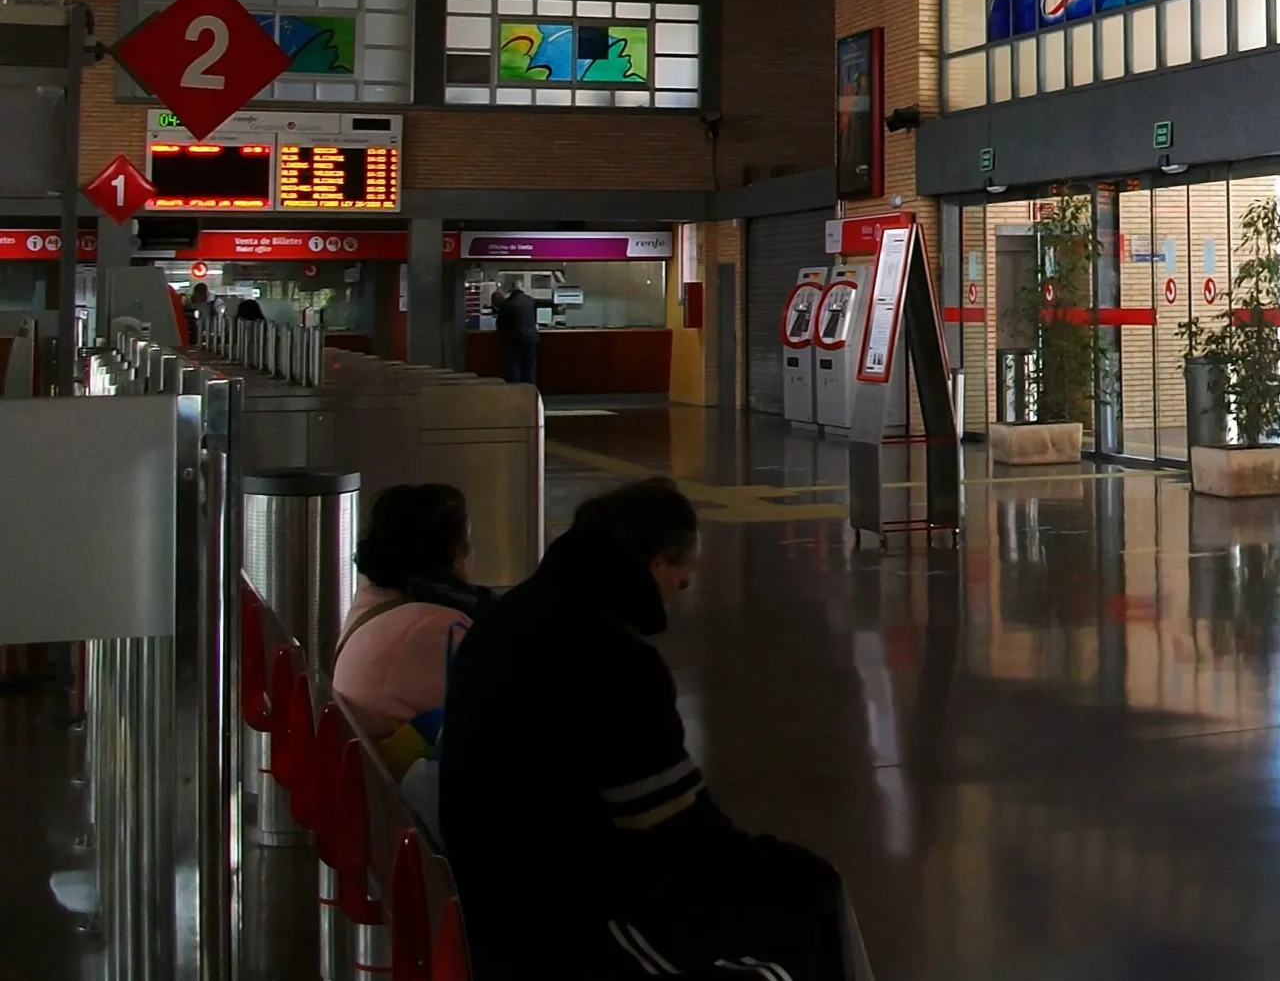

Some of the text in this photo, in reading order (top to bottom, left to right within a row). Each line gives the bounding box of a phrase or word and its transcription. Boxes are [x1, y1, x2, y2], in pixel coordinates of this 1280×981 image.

[180, 15, 230, 89] 2
[111, 175, 125, 206] 1
[234, 237, 303, 245] Venta de Billetes
[635, 238, 666, 249] renfe
